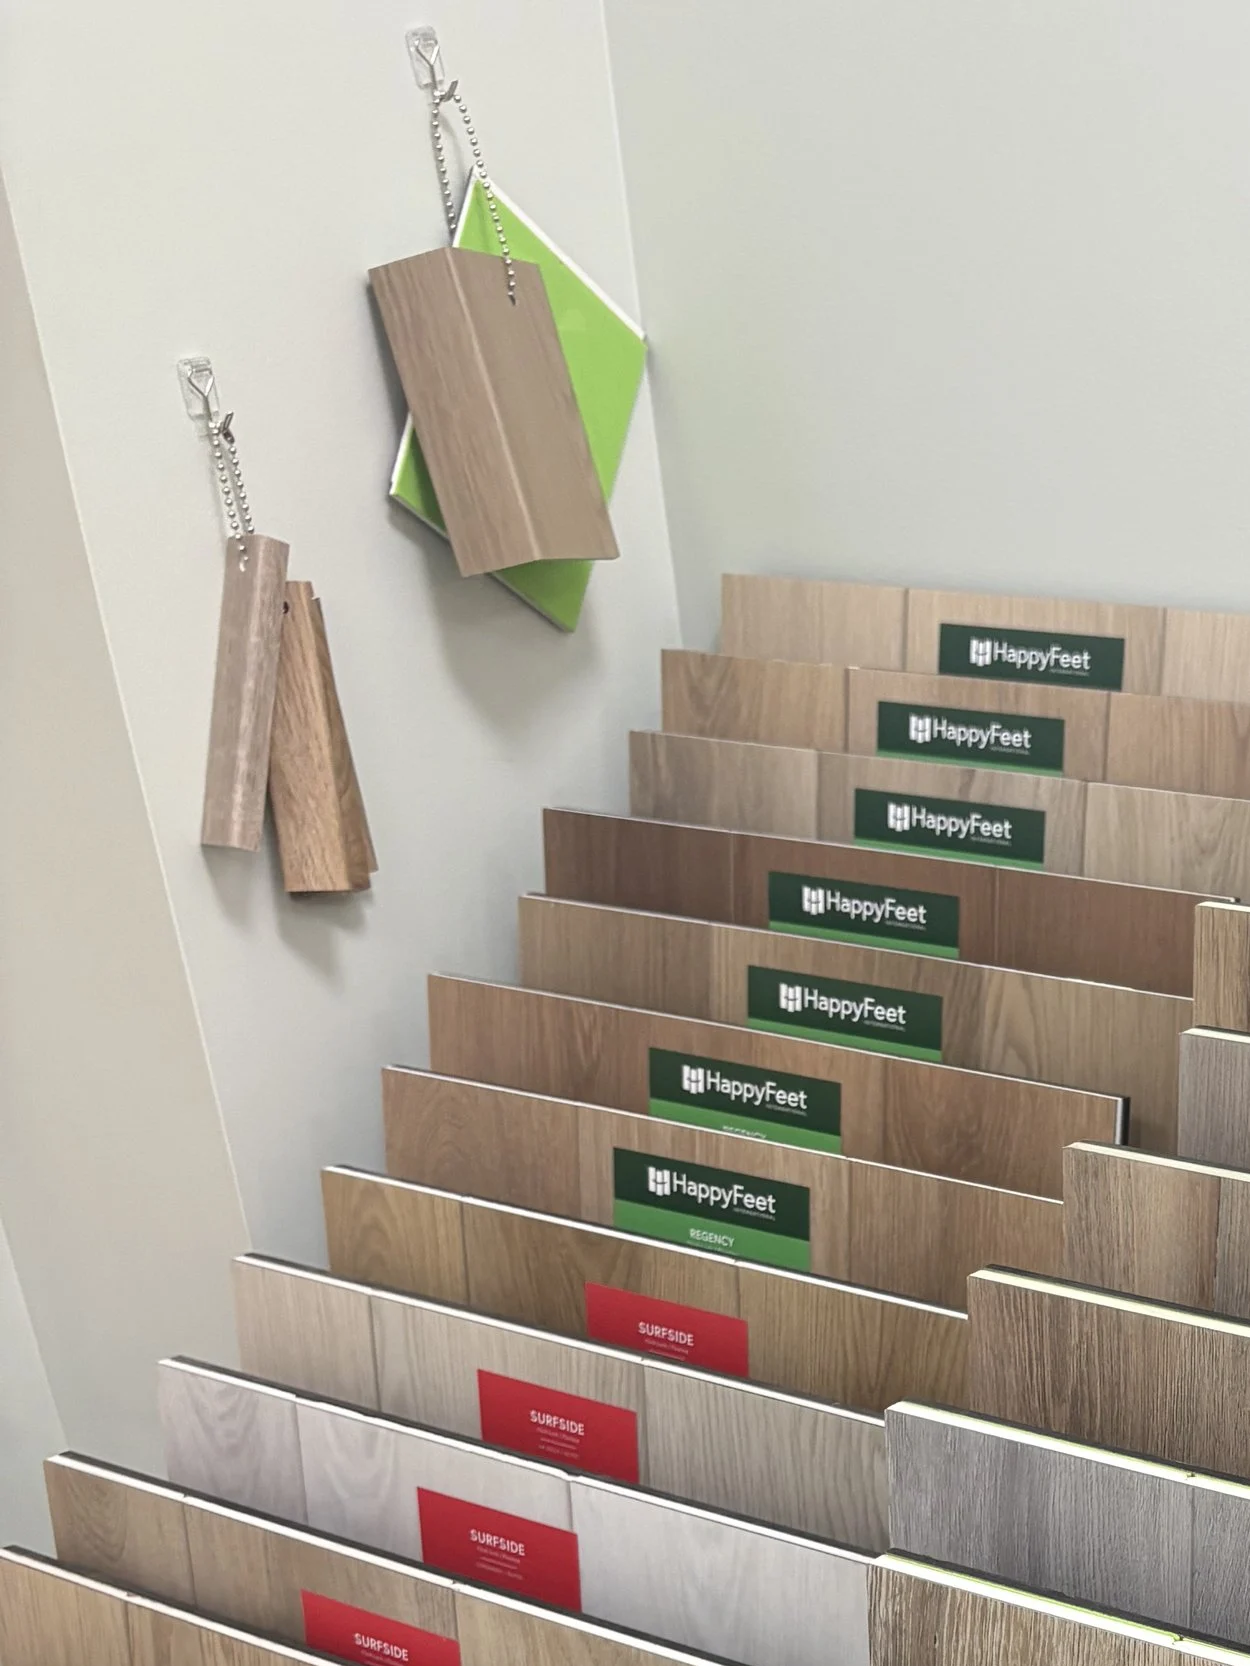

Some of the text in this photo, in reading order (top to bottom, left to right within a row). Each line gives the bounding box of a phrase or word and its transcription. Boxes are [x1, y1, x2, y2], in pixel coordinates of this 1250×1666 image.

[993, 640, 1091, 671] HappyFeet
[932, 717, 1032, 749] HappyFeet
[912, 805, 1012, 839] HappyFeet
[826, 889, 927, 924] HappyFeet
[803, 987, 907, 1024] HappyFeet
[706, 1070, 808, 1109] HappyFeet
[672, 1172, 776, 1213] HappyFeet
[689, 1228, 734, 1247] REGENCY
[638, 1321, 695, 1346] SURFSIDE
[530, 1409, 585, 1436] SURFSIDE
[470, 1529, 525, 1556] SURFSIDE
[354, 1632, 409, 1662] SURFSIDE
